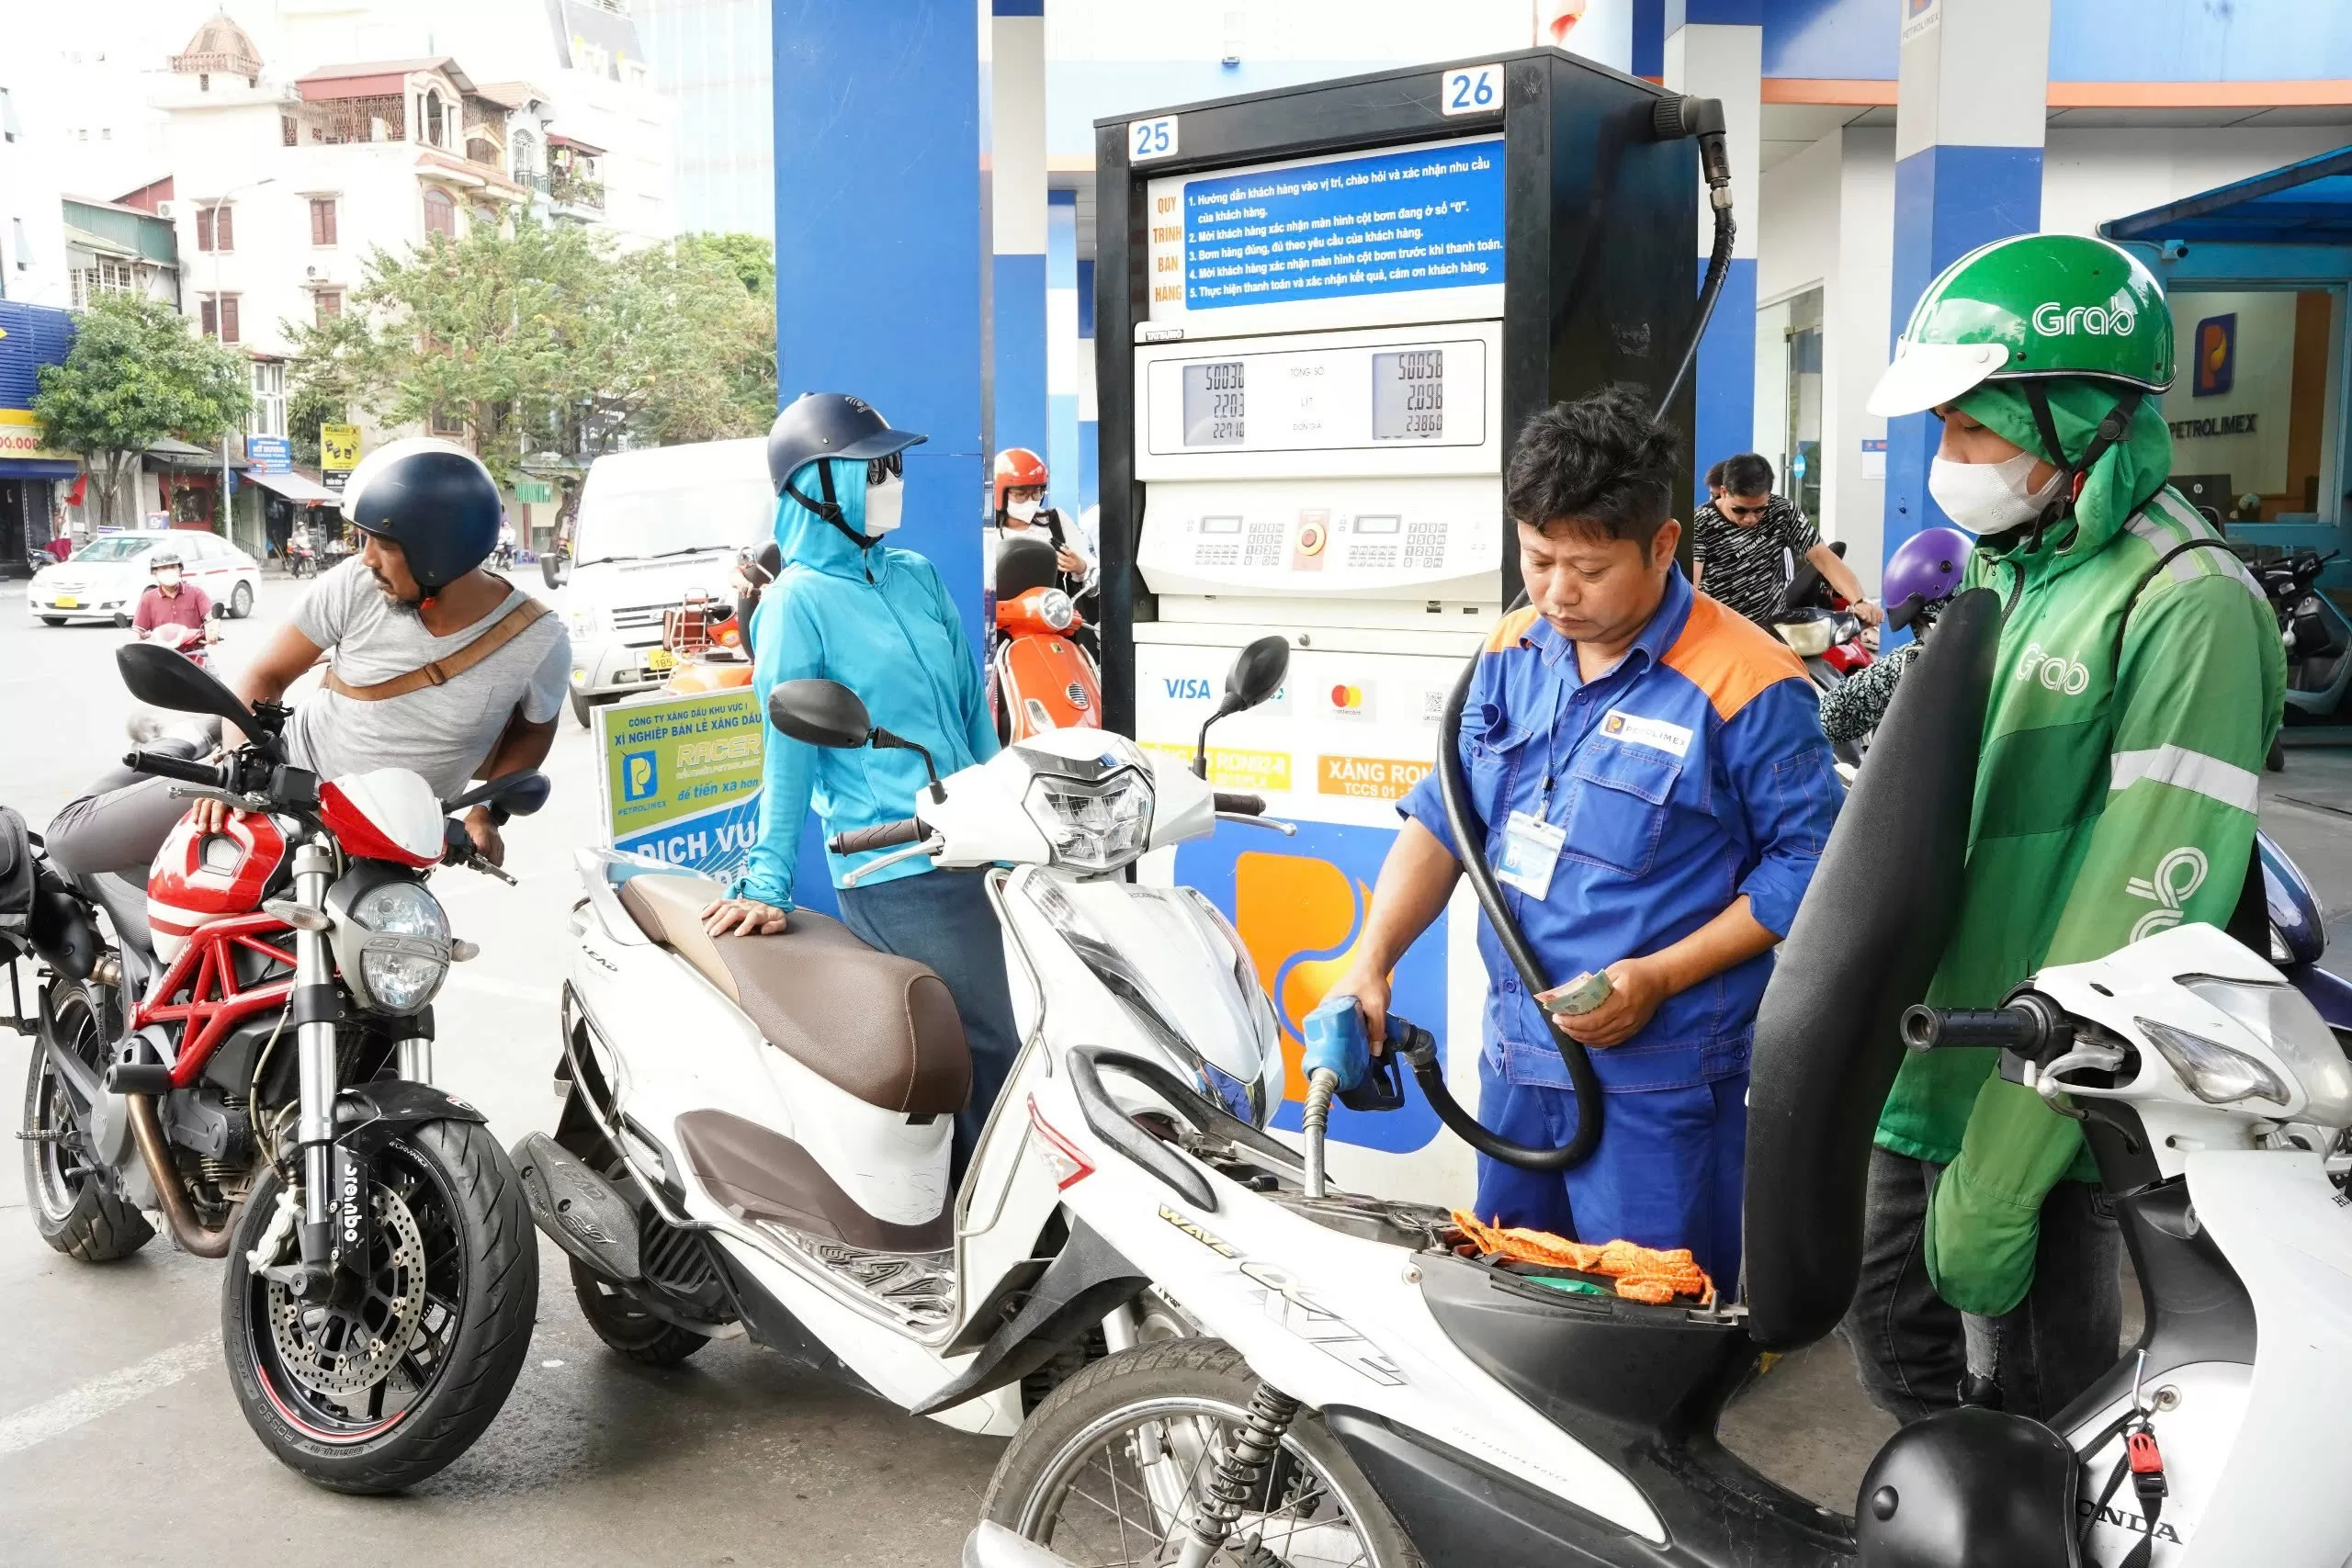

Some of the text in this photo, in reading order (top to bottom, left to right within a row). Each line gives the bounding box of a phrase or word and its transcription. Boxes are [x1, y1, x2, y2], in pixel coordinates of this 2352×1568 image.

[1452, 72, 1493, 108] 26
[1136, 121, 1170, 154] 25
[1158, 196, 1177, 215] QUY
[1189, 196, 1195, 206] 1.
[1153, 224, 1182, 243] TRÌNH
[1189, 232, 1196, 243] 2.
[1189, 251, 1197, 262] 3.
[1189, 269, 1197, 279] 4.
[1155, 283, 1182, 302] HÀNG
[1190, 288, 1197, 299] 5.
[2032, 295, 2135, 336] Grab
[1398, 352, 1442, 379] 50058
[1206, 364, 1244, 390] 50030
[1406, 413, 1442, 432] 23860
[2017, 642, 2089, 695] Grab
[1162, 678, 1211, 699] VISA
[629, 716, 651, 727] CÔNG
[654, 715, 664, 723] TY
[667, 711, 689, 721] XĂNG
[692, 708, 707, 718] DẦU
[709, 706, 726, 715] KHU
[629, 728, 668, 743] NGHIỆP
[672, 724, 693, 737] BÁN
[711, 716, 739, 729] XĂNG
[677, 734, 761, 768] RACER
[1329, 758, 1385, 781] XĂNG
[694, 781, 718, 797] tiến
[722, 781, 737, 793] xa
[1344, 783, 1377, 795] TCCS
[617, 800, 667, 816] PETROLIMEX
[344, 1163, 362, 1242] brembo
[1159, 1202, 1244, 1258] WAVE
[2078, 1499, 2184, 1545] ONDA
